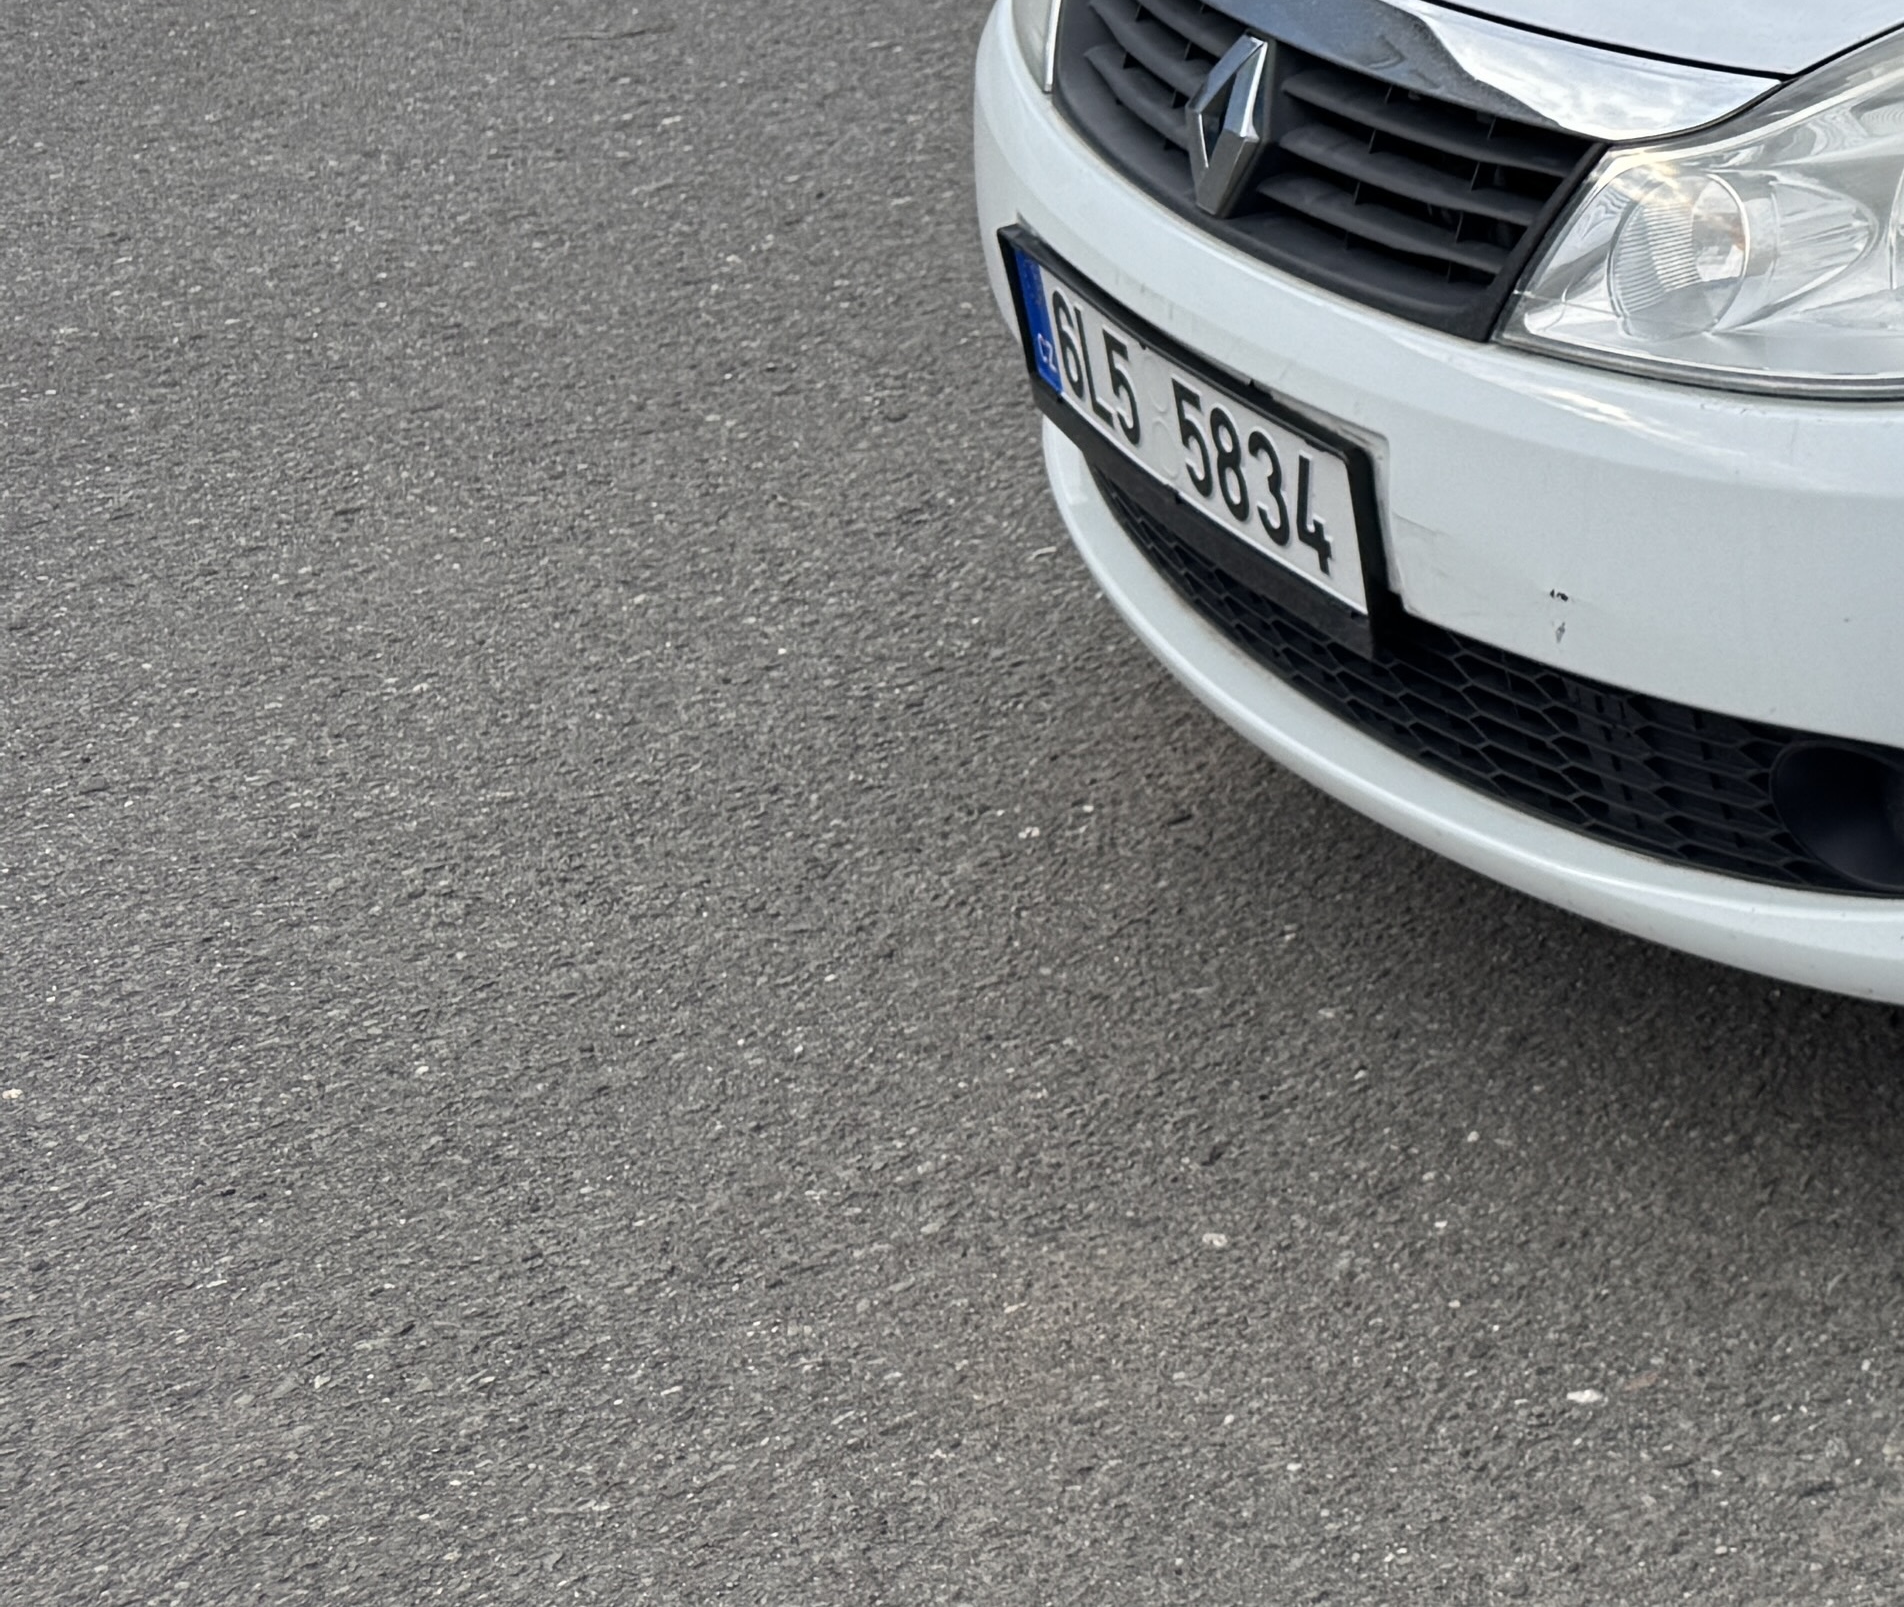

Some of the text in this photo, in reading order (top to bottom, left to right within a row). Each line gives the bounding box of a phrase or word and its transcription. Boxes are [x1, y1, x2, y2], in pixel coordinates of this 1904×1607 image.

[1037, 333, 1058, 374] CZ
[1052, 289, 1333, 577] 6L5 5834
